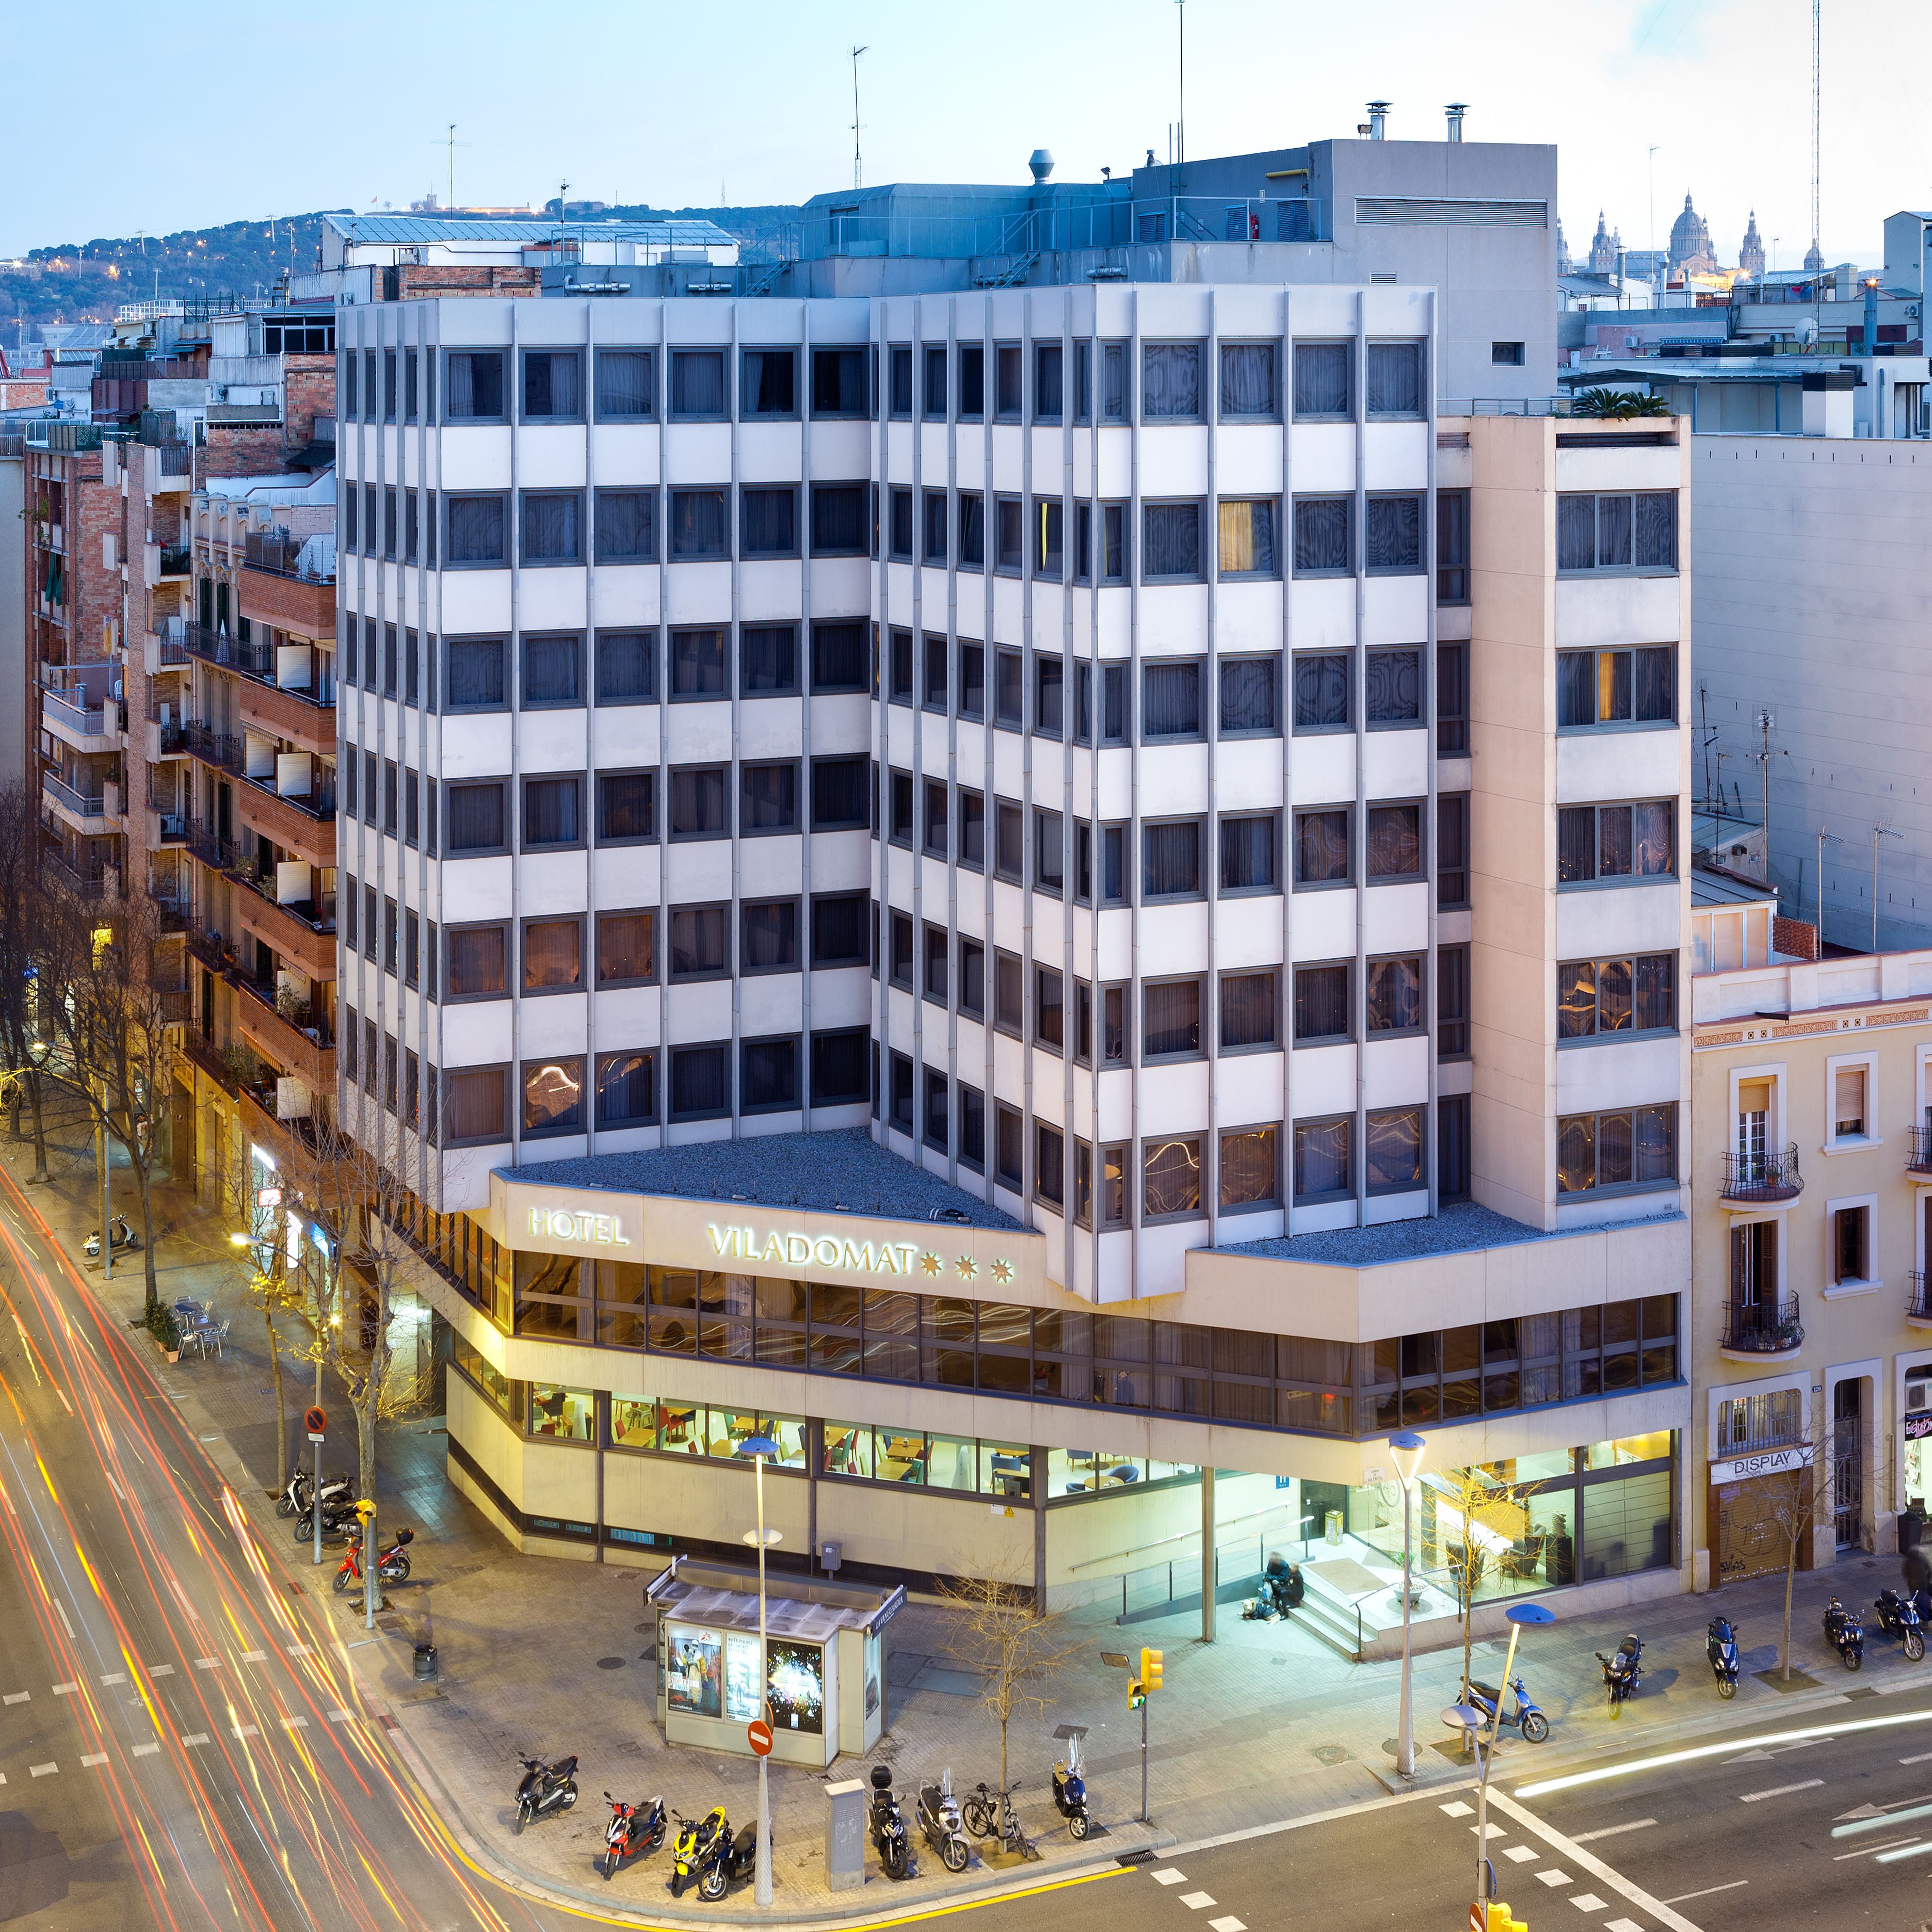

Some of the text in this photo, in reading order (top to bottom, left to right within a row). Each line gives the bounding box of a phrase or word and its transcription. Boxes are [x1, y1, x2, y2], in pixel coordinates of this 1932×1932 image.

[528, 1208, 916, 1275] HOTEL VILADOMAT
[1735, 1452, 1791, 1474] DISPLAY
